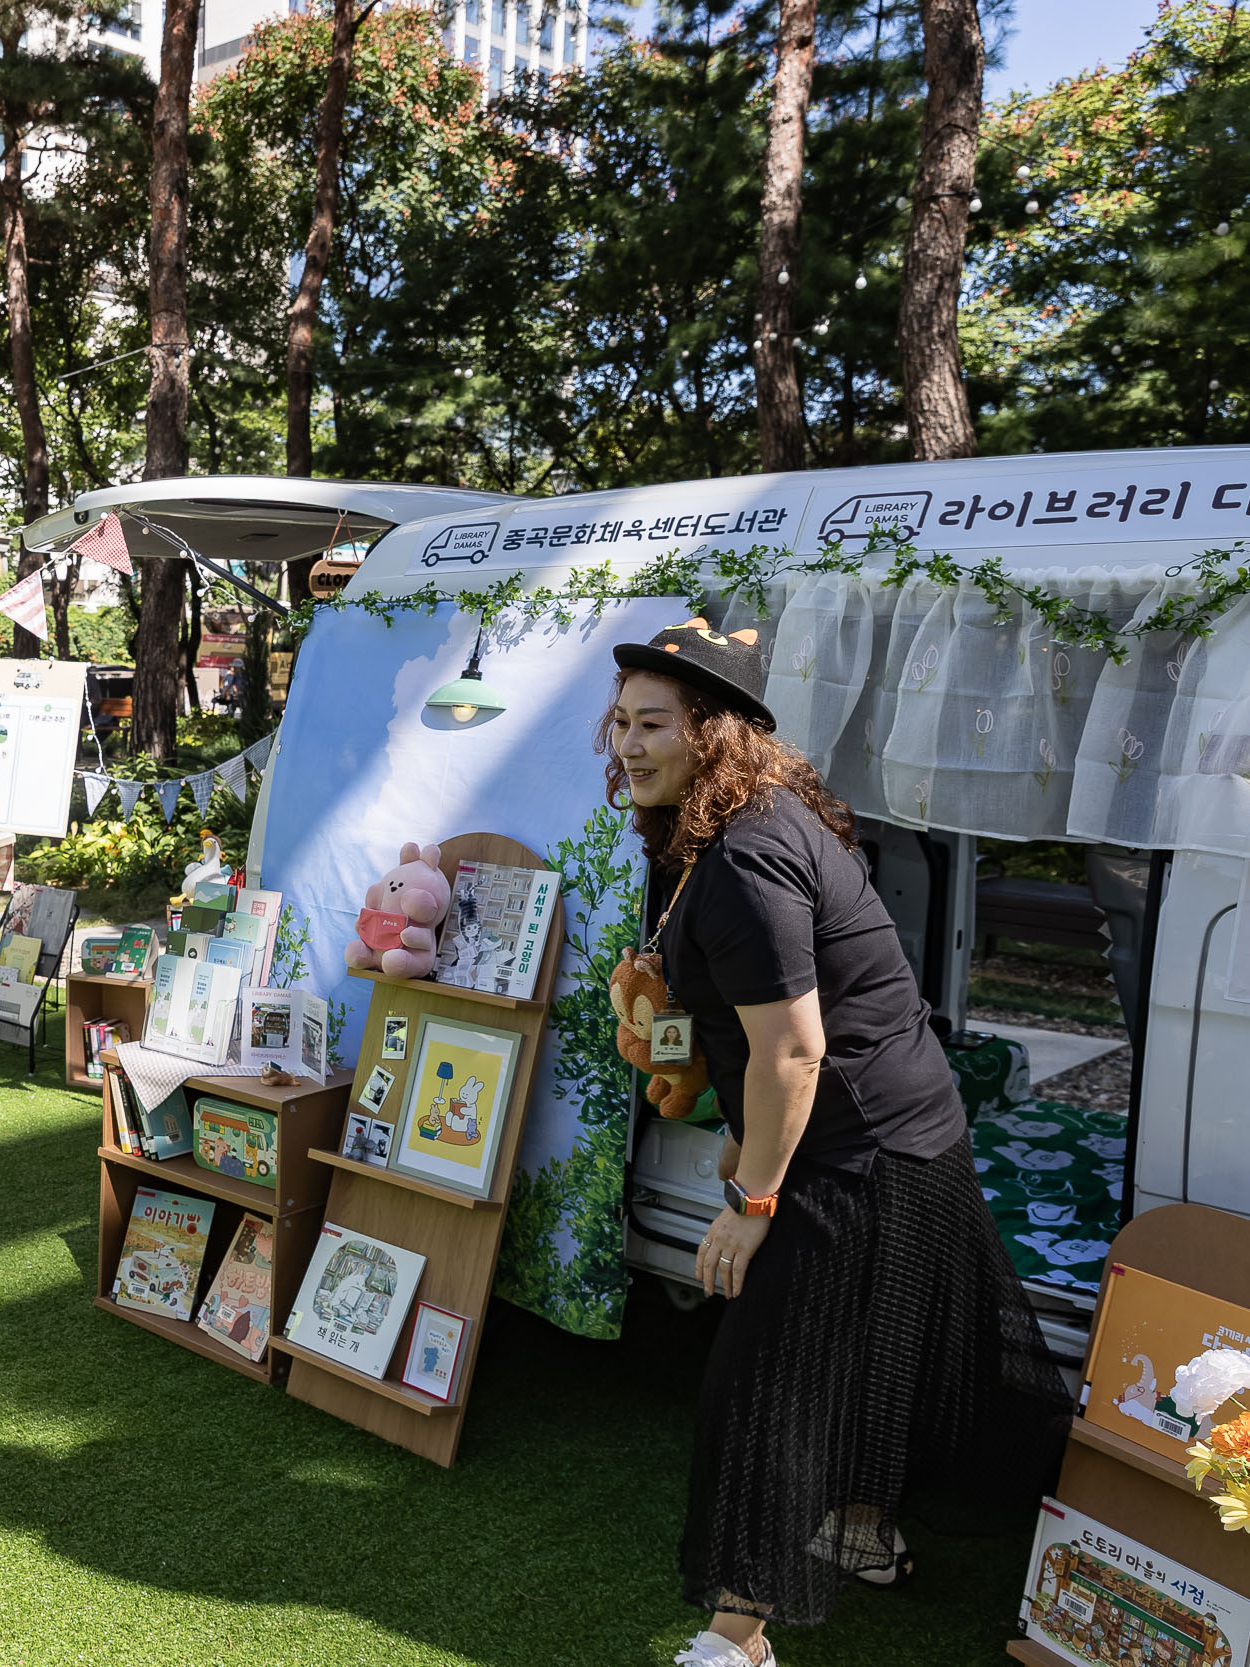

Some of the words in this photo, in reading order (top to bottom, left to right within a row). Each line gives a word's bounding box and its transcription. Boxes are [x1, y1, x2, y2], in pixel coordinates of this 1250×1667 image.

[864, 501, 918, 514] LIBRARY
[938, 481, 1192, 530] 라이브러리
[502, 508, 789, 552] 중곡문화체육센터도서관
[864, 514, 909, 525] DAMAS
[453, 541, 484, 550] DAMAS
[454, 530, 490, 541] LIBRARY
[534, 883, 549, 917] 사서가
[528, 923, 539, 934] 된
[518, 939, 534, 974] 고양이
[317, 1326, 327, 1339] 책
[328, 1331, 347, 1349] 읽는
[349, 1340, 360, 1353] 개
[1216, 1325, 1245, 1343] 코끼리
[1080, 1529, 1122, 1563] 도토리
[1125, 1556, 1167, 1584] 마을의
[1170, 1580, 1205, 1606] 서점
